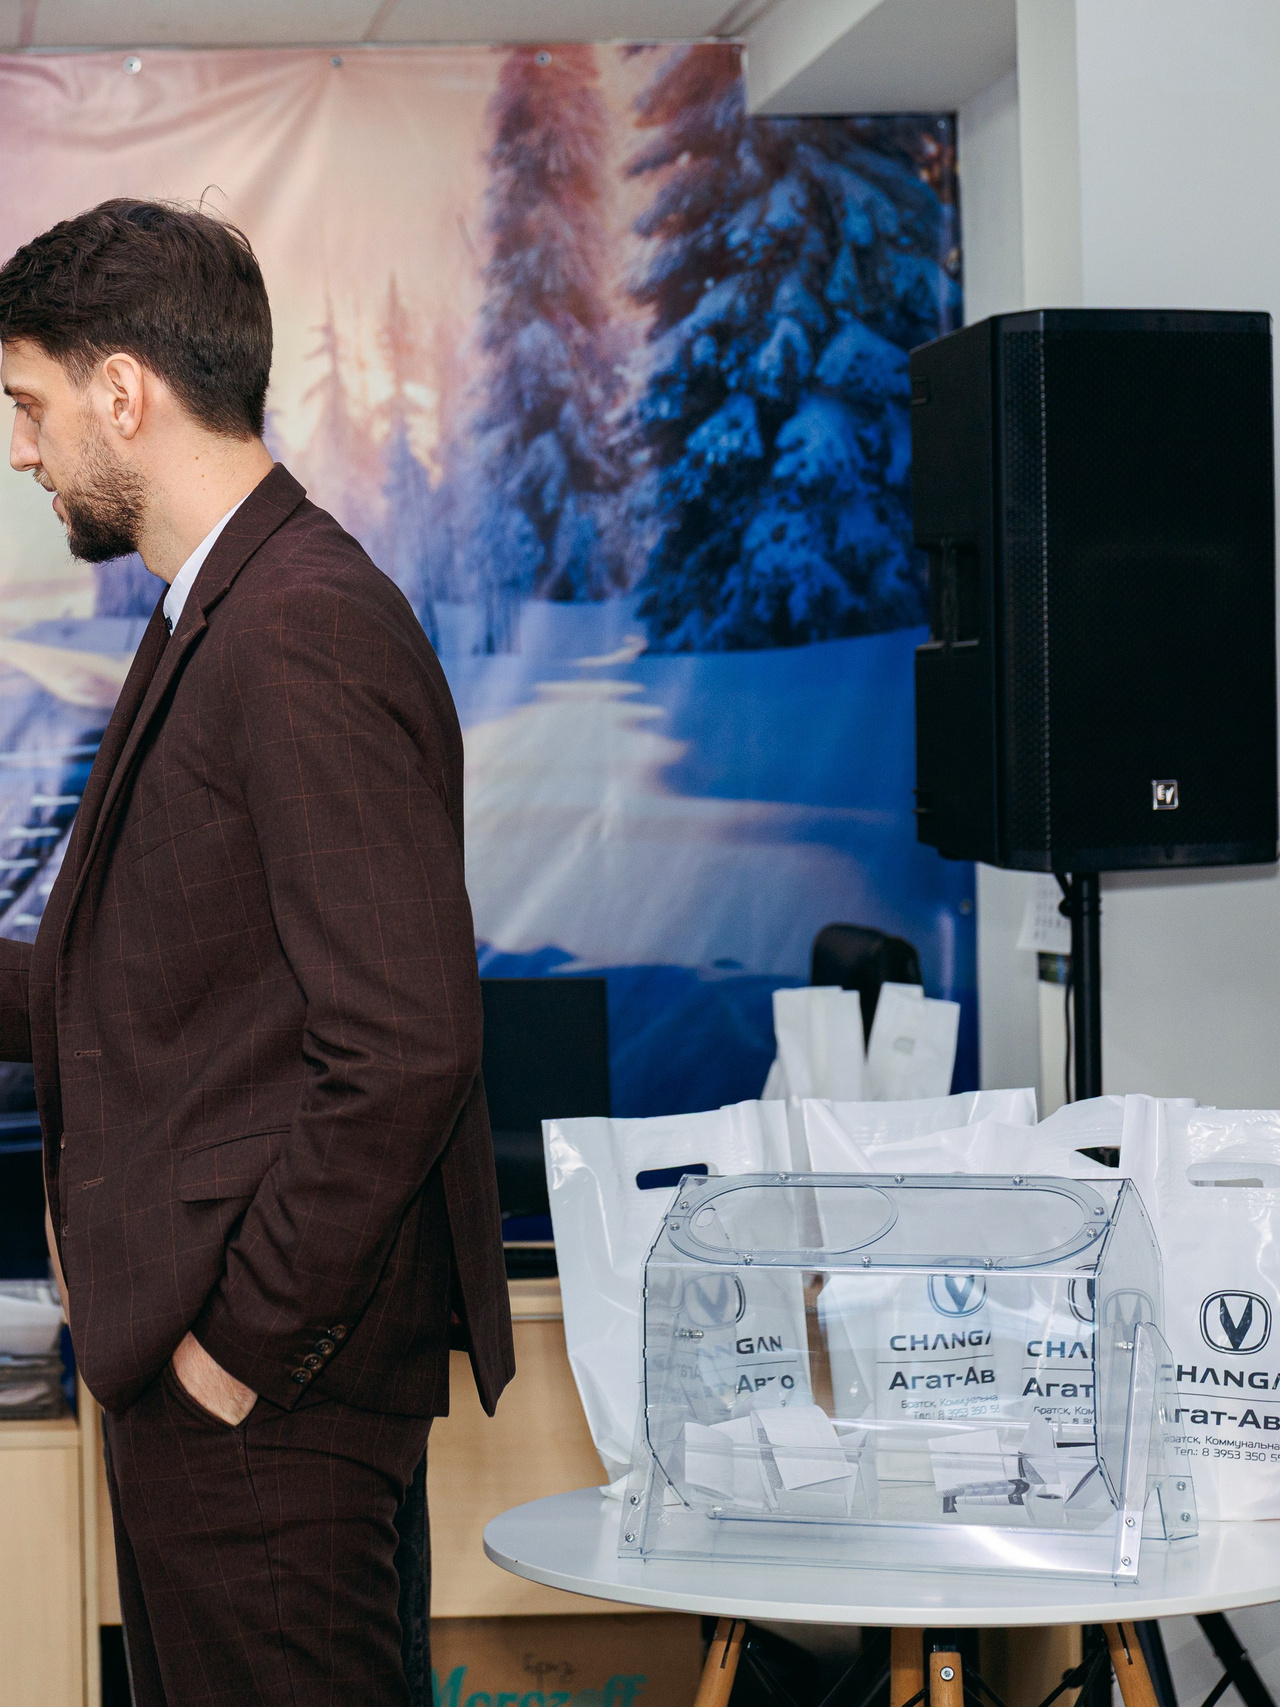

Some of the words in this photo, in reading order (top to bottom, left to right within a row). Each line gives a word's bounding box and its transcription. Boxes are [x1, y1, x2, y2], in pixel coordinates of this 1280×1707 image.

[1174, 1446, 1198, 1456] Тел.:
[1201, 1448, 1209, 1457] 8
[1214, 1448, 1241, 1459] 3953
[1245, 1451, 1266, 1462] 350
